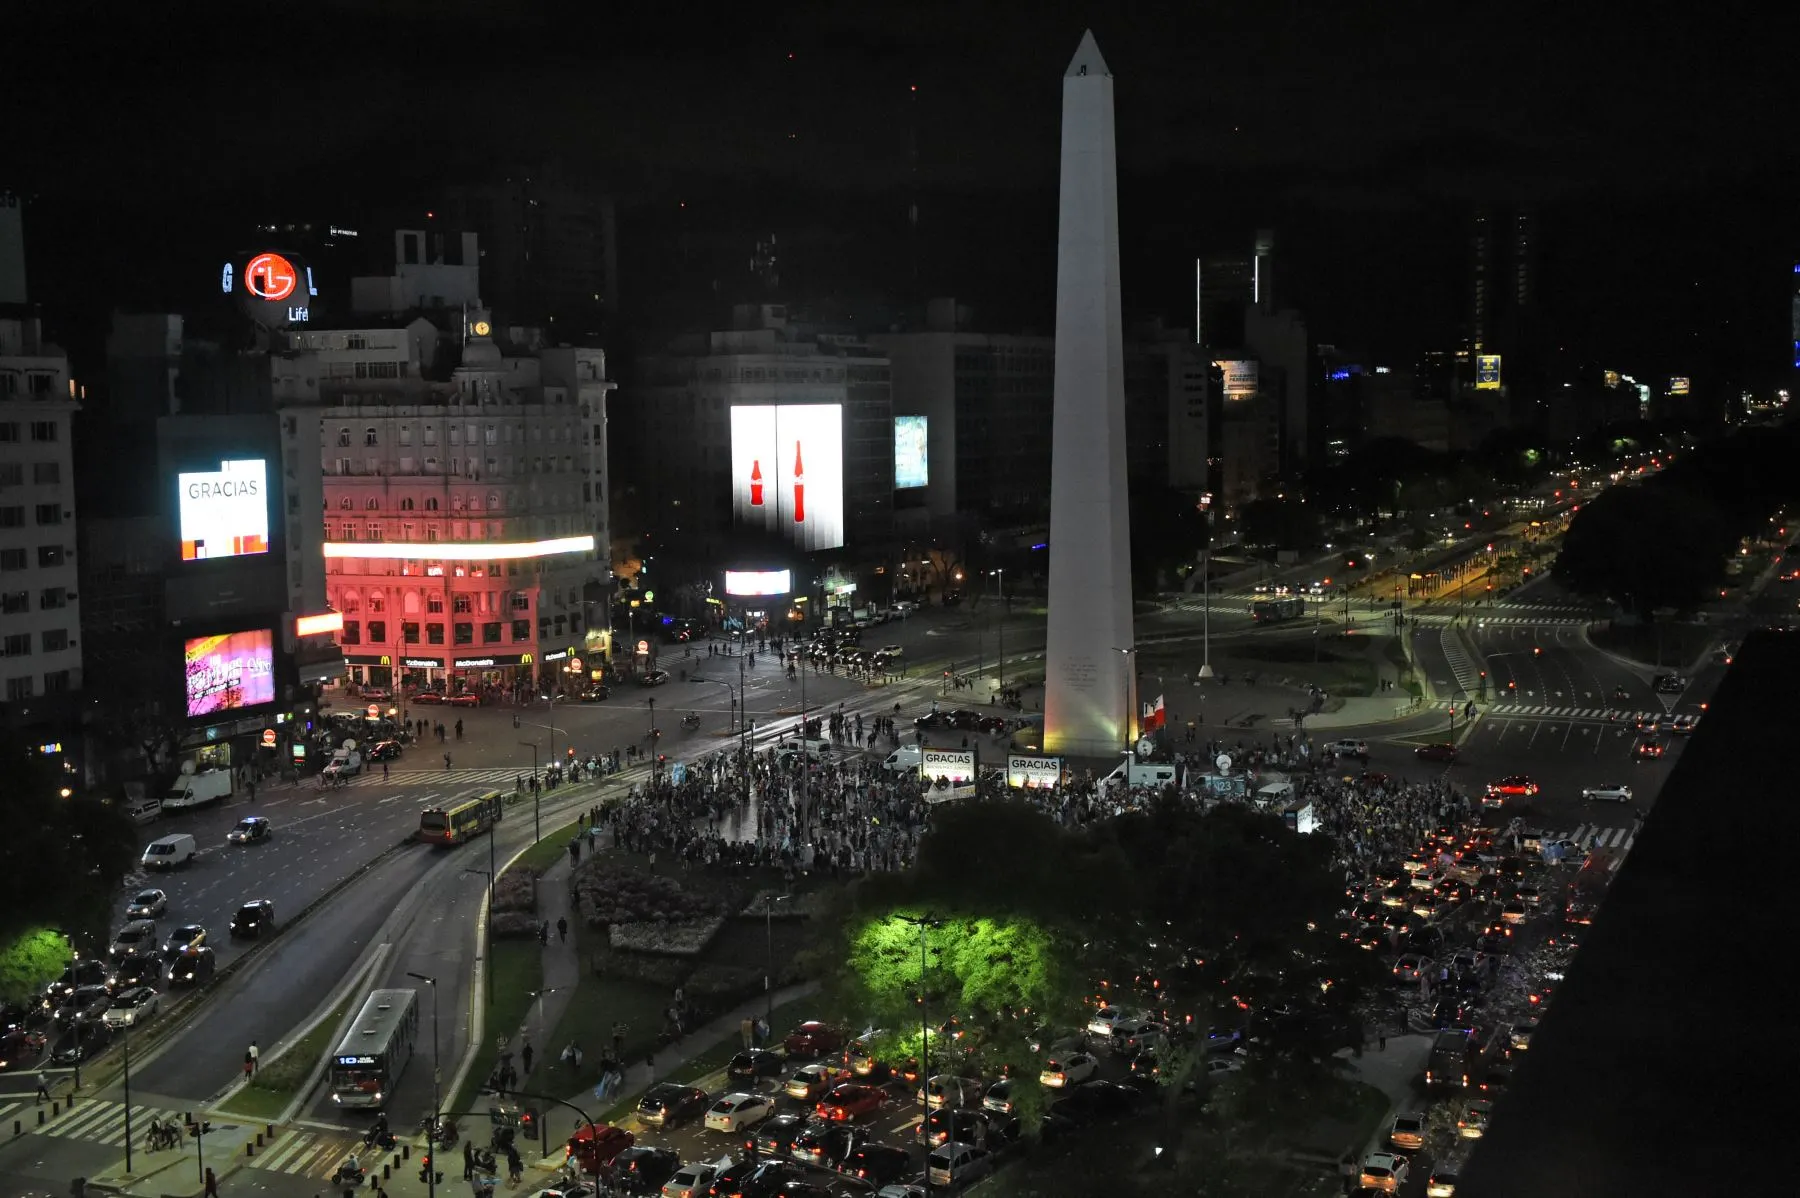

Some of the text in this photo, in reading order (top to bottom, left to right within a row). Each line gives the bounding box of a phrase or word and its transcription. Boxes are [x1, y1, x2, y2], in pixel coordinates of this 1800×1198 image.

[188, 480, 258, 499] GRACIAS
[925, 753, 971, 764] GRACIAS
[1011, 759, 1058, 770] GRACIAS
[339, 1056, 357, 1065] 10
